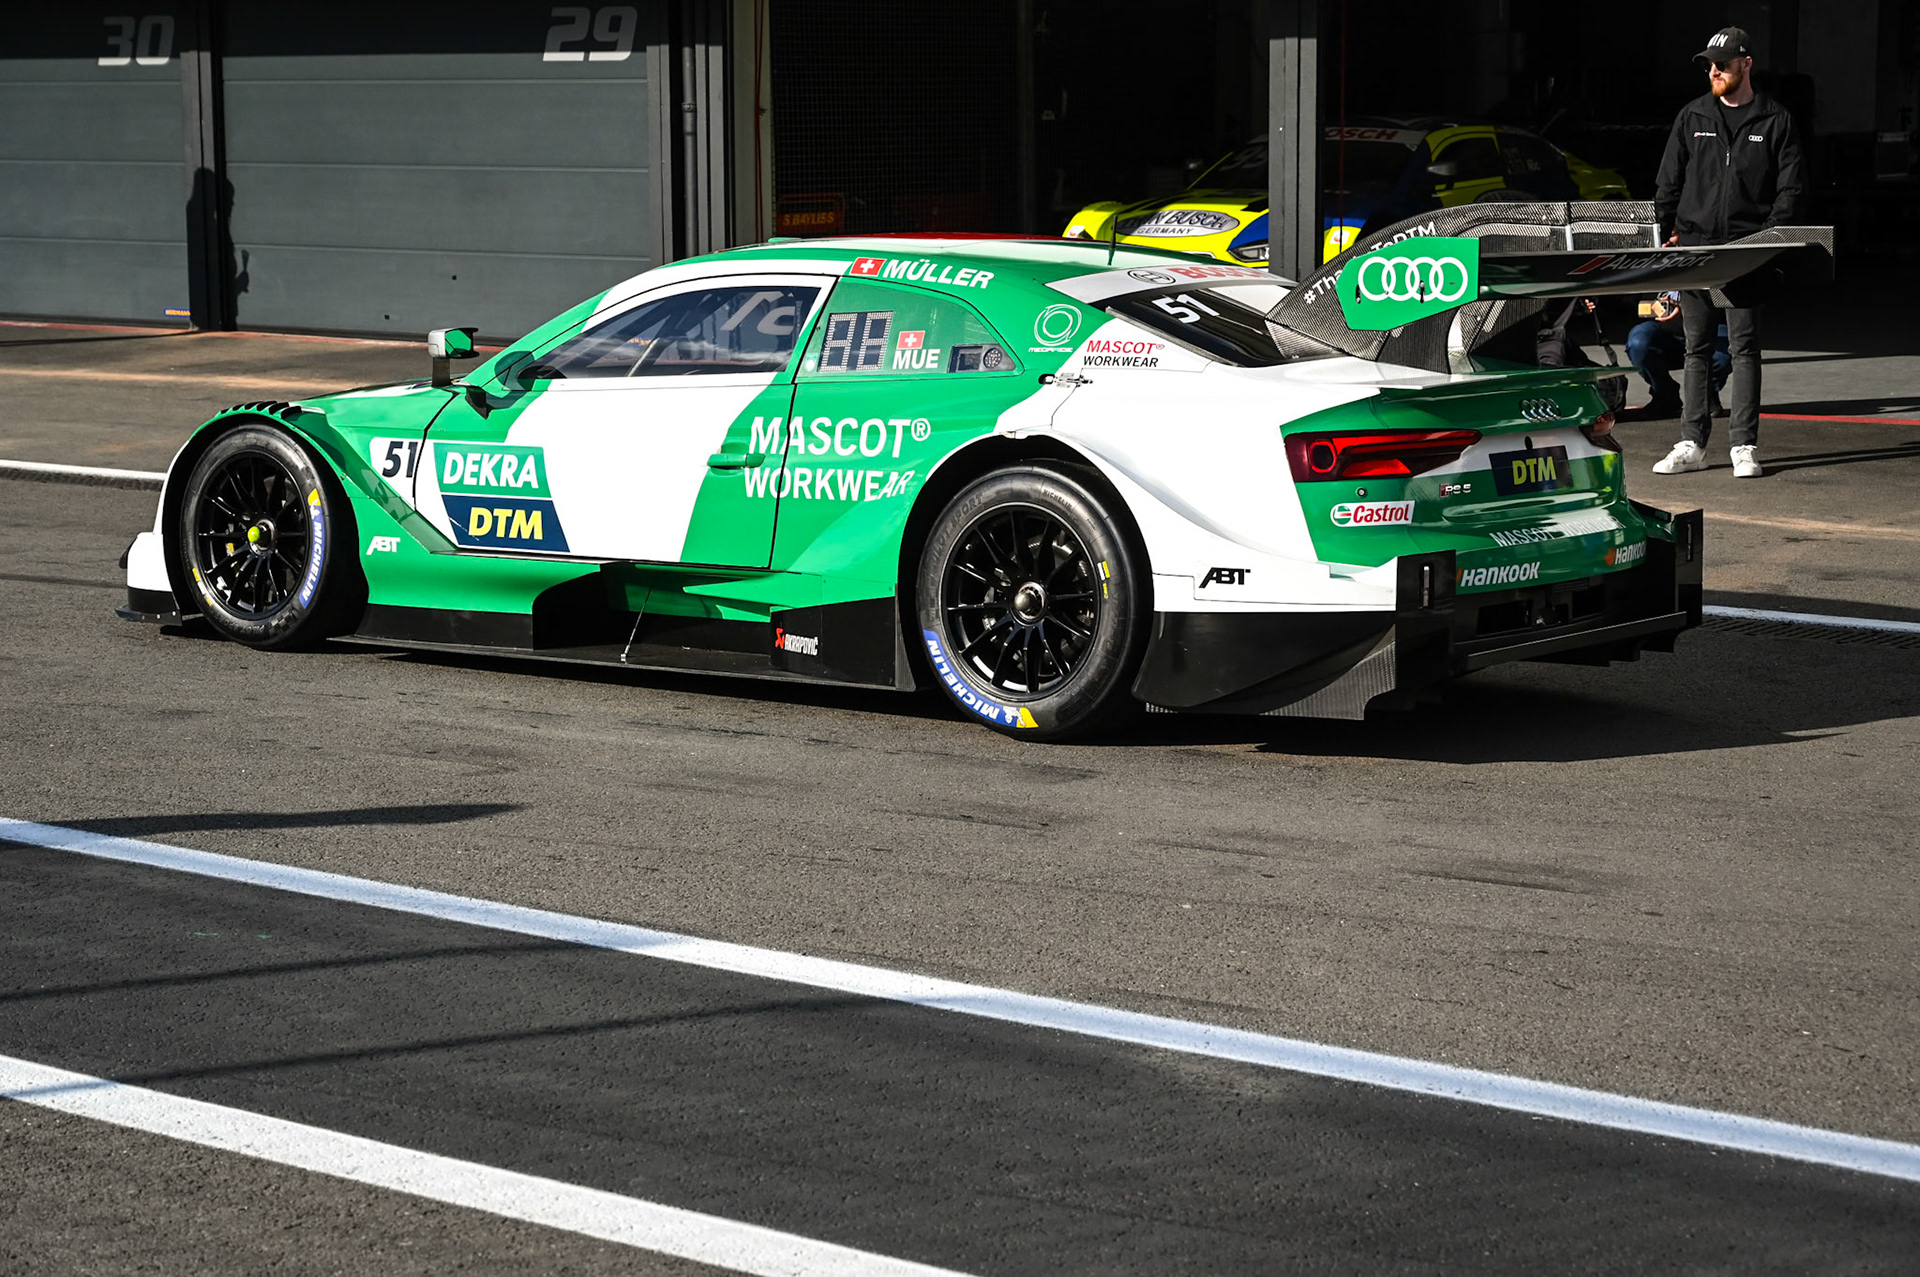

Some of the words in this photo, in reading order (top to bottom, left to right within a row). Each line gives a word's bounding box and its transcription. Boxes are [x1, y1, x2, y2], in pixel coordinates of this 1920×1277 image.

[96, 15, 175, 67] 30
[541, 5, 638, 62] 29
[1325, 129, 1399, 140] OSCH
[1137, 227, 1194, 235] GERMANY
[1165, 210, 1228, 228] BUSCH
[882, 258, 995, 290] MÜLLER
[1600, 254, 1659, 271] Audi
[1651, 252, 1716, 272] Sport
[1151, 294, 1220, 324] 51
[892, 349, 941, 370] MUE
[1083, 355, 1159, 368] WORKWEAR
[382, 440, 419, 479] 51
[442, 451, 540, 489] DEKRA
[1511, 456, 1558, 486] DTM
[743, 467, 916, 502] WORKWEAR
[1042, 488, 1074, 509] MICHELIN
[468, 506, 544, 540] DTM
[1353, 503, 1410, 524] Castrol
[366, 535, 401, 555] ABT
[1489, 525, 1556, 548] MASCOT
[302, 521, 323, 602] MICHELIN
[1198, 566, 1251, 589] ABT
[926, 639, 1000, 721] MICHELIN
